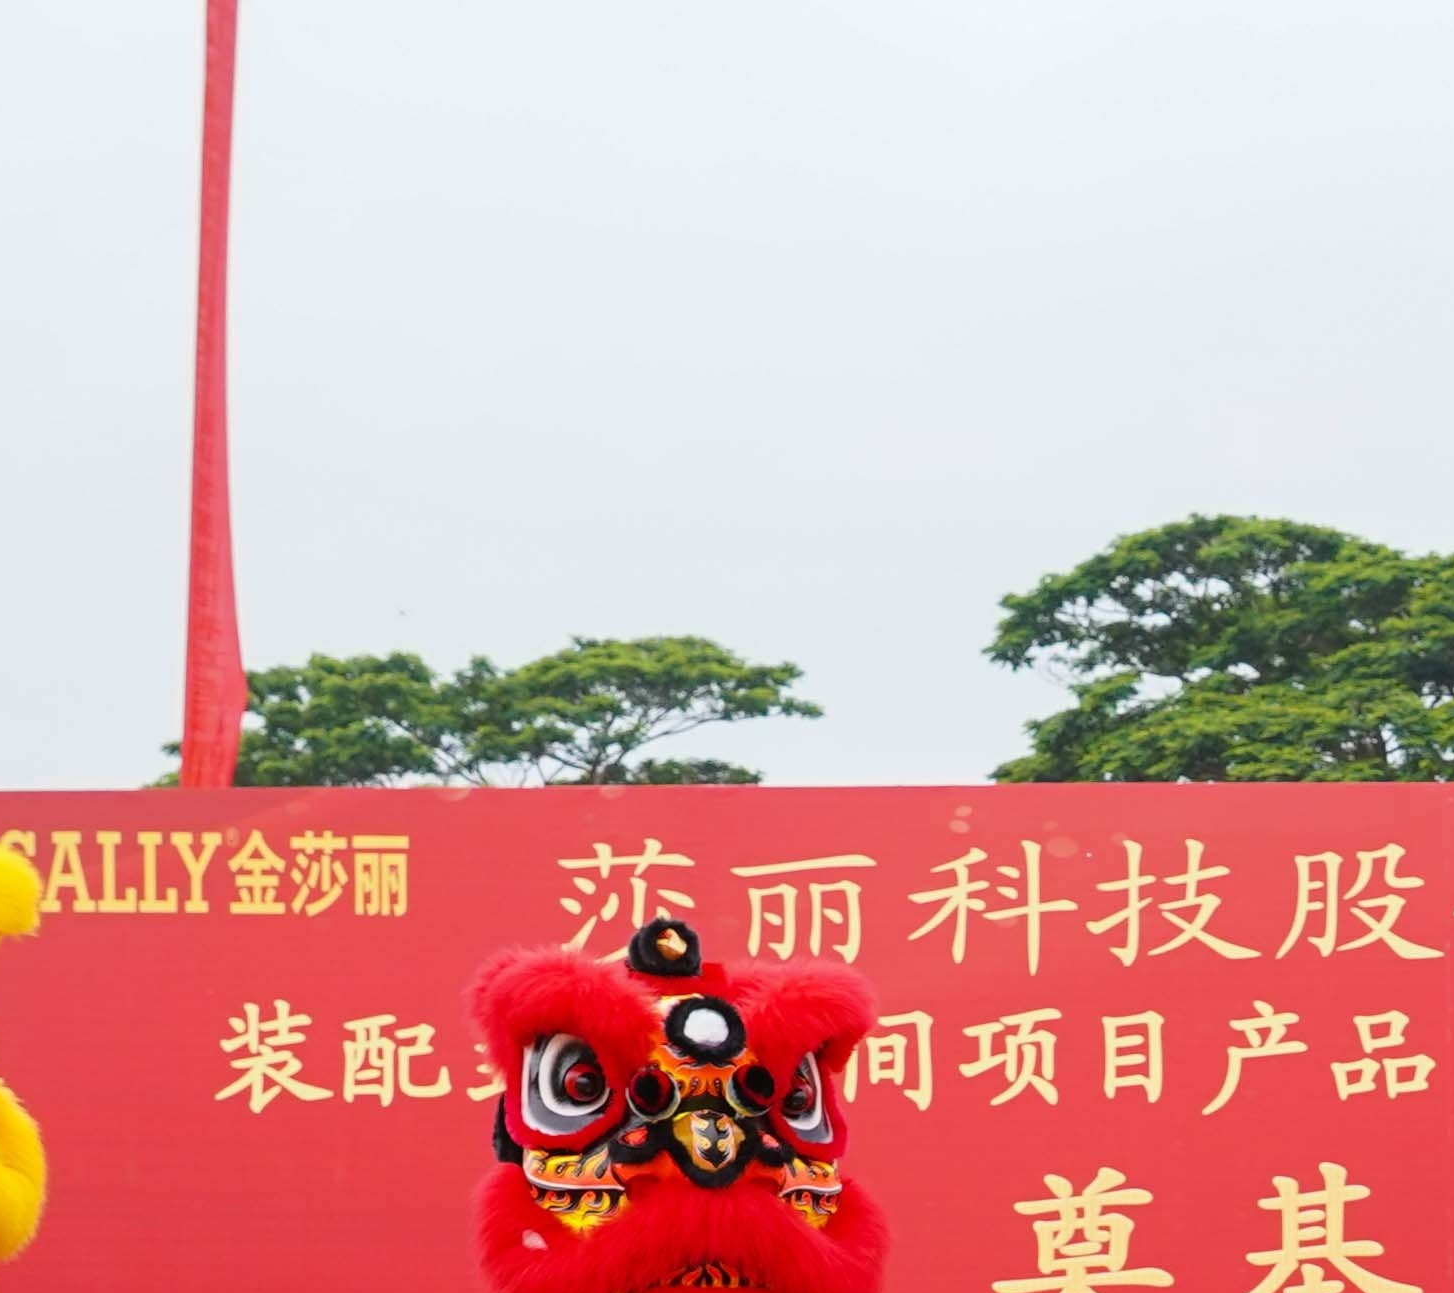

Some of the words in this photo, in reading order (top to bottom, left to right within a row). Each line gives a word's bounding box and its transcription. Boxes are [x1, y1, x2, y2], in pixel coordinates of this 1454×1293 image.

[2, 829, 222, 914] ALLY
[227, 829, 410, 917] 金莎丽
